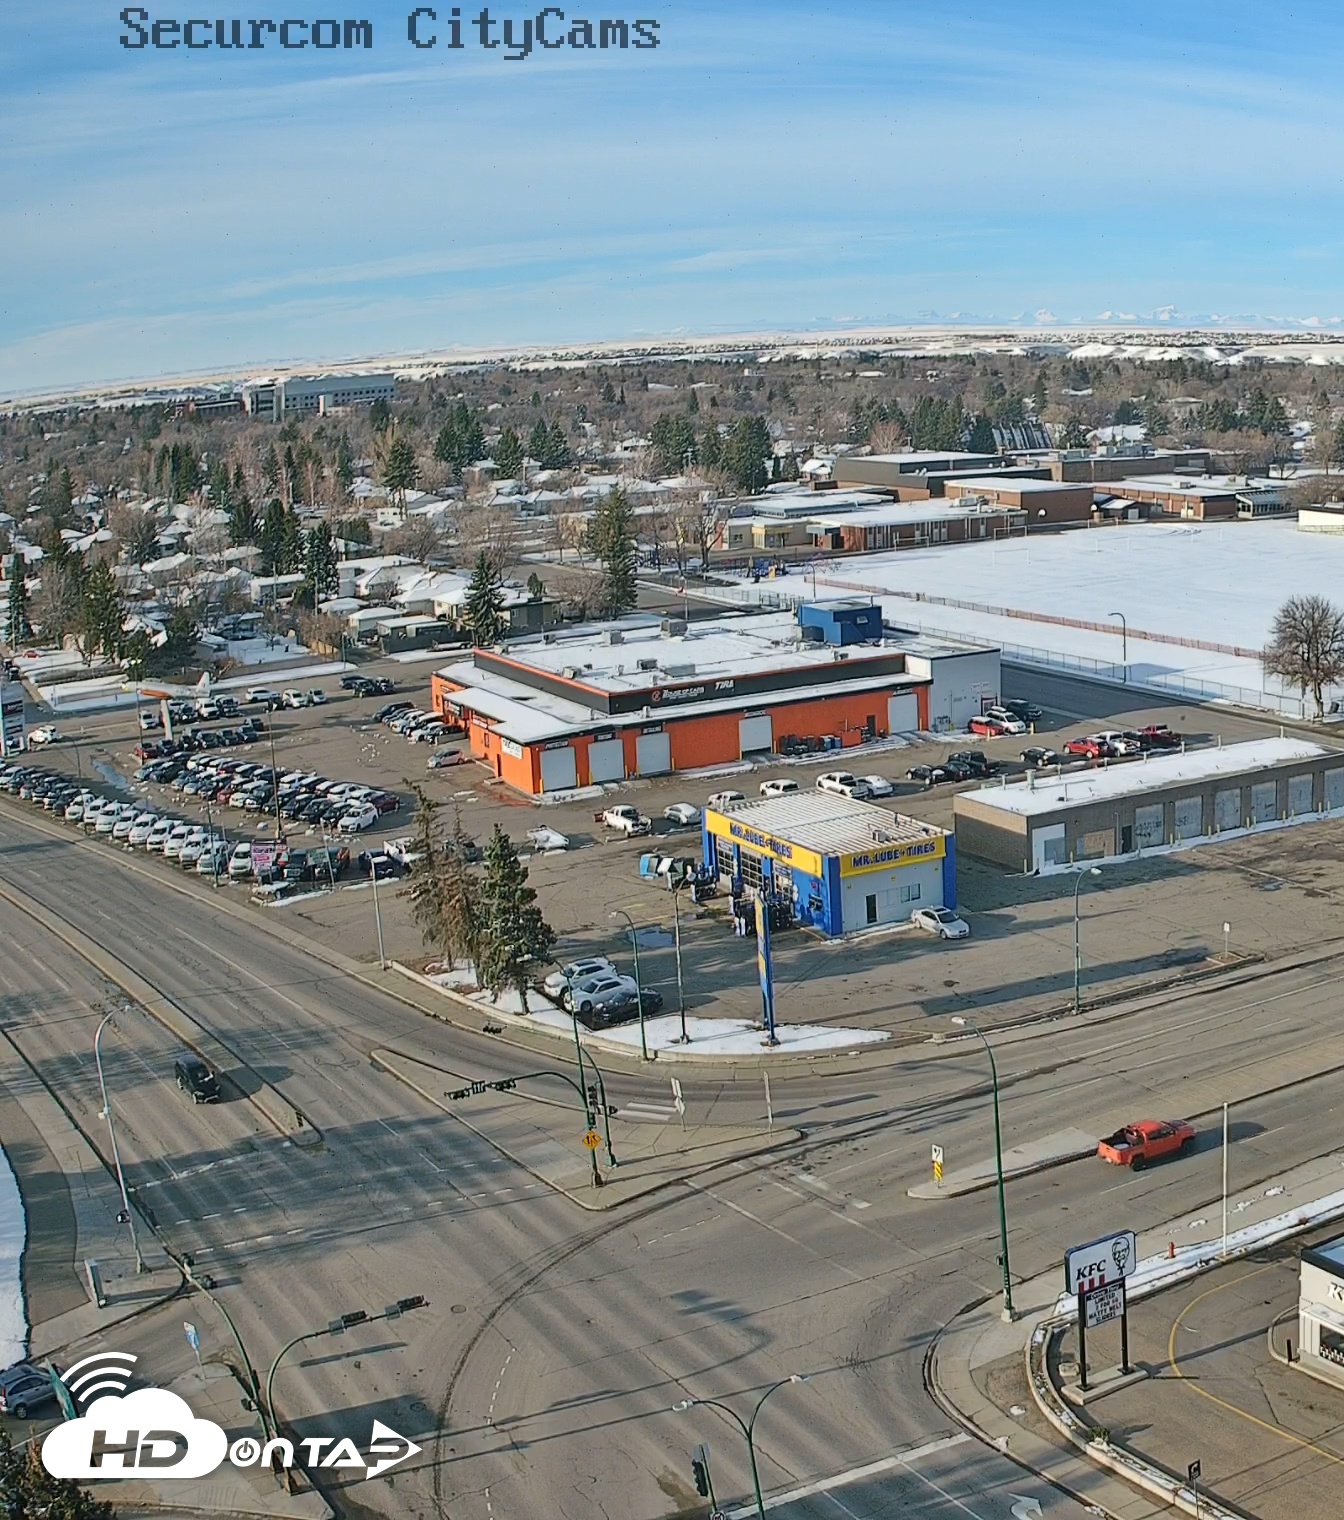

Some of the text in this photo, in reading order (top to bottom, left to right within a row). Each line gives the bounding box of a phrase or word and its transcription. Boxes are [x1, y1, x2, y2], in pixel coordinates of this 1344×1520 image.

[730, 822, 747, 840] MR.
[745, 828, 765, 848] LUBE
[770, 839, 793, 859] TIRES
[853, 855, 874, 867] MR.
[874, 850, 900, 864] LUBE
[907, 841, 936, 857] TIRES
[1076, 1259, 1107, 1281] KFC
